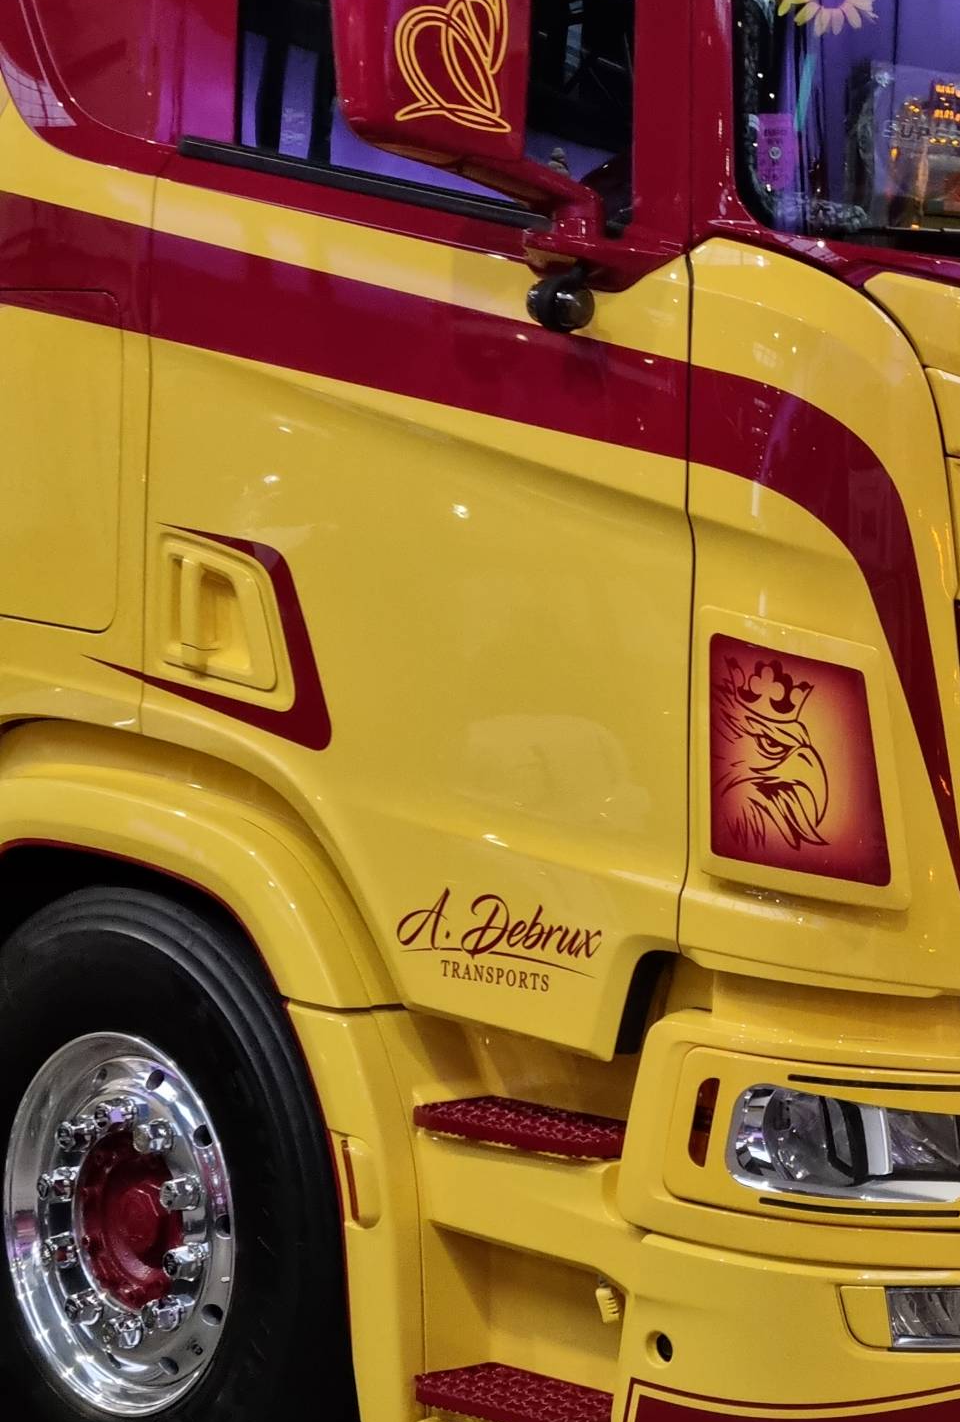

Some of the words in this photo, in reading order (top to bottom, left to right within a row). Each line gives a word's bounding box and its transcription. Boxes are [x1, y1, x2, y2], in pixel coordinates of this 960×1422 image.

[396, 887, 451, 950] A.
[461, 894, 603, 959] Debrux
[440, 959, 550, 992] TRANSPORTS
